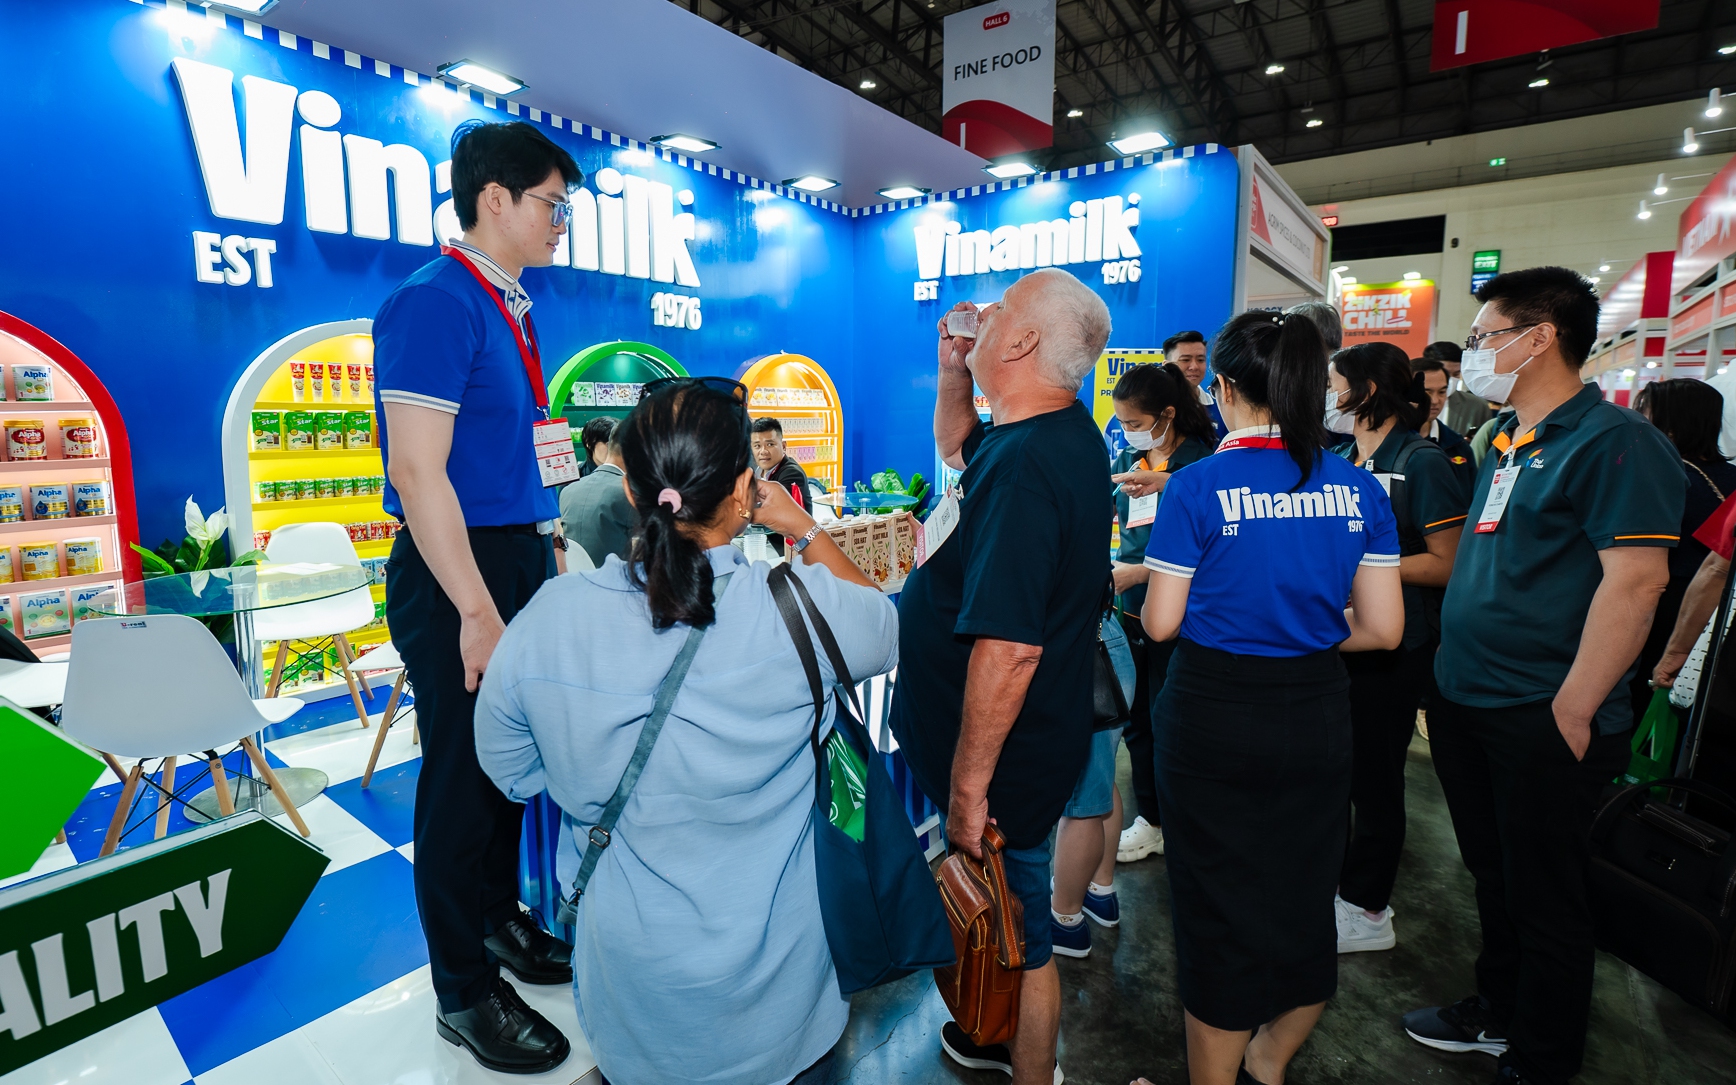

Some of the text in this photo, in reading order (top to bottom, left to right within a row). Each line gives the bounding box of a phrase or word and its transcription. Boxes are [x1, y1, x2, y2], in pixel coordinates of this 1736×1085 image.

[985, 17, 1002, 27] HALL
[954, 45, 1041, 81] FINE FOOD
[914, 192, 1143, 280] Vinamilk
[1451, 237, 1459, 248] 9
[192, 230, 277, 288] EST
[1101, 259, 1143, 284] 1976
[913, 281, 939, 301] EST
[650, 291, 702, 330] 1976
[1343, 309, 1412, 330] CHILL
[24, 371, 46, 379] Alpha
[18, 431, 41, 440] Alpha
[38, 488, 62, 497] Alpha
[78, 486, 101, 495] Alpha
[1216, 484, 1362, 522] Vinamilk
[1222, 524, 1239, 536] EST
[1347, 520, 1364, 533] 1976
[27, 550, 49, 559] Alpha
[68, 546, 88, 554] Alpha
[26, 597, 61, 608] Alpha
